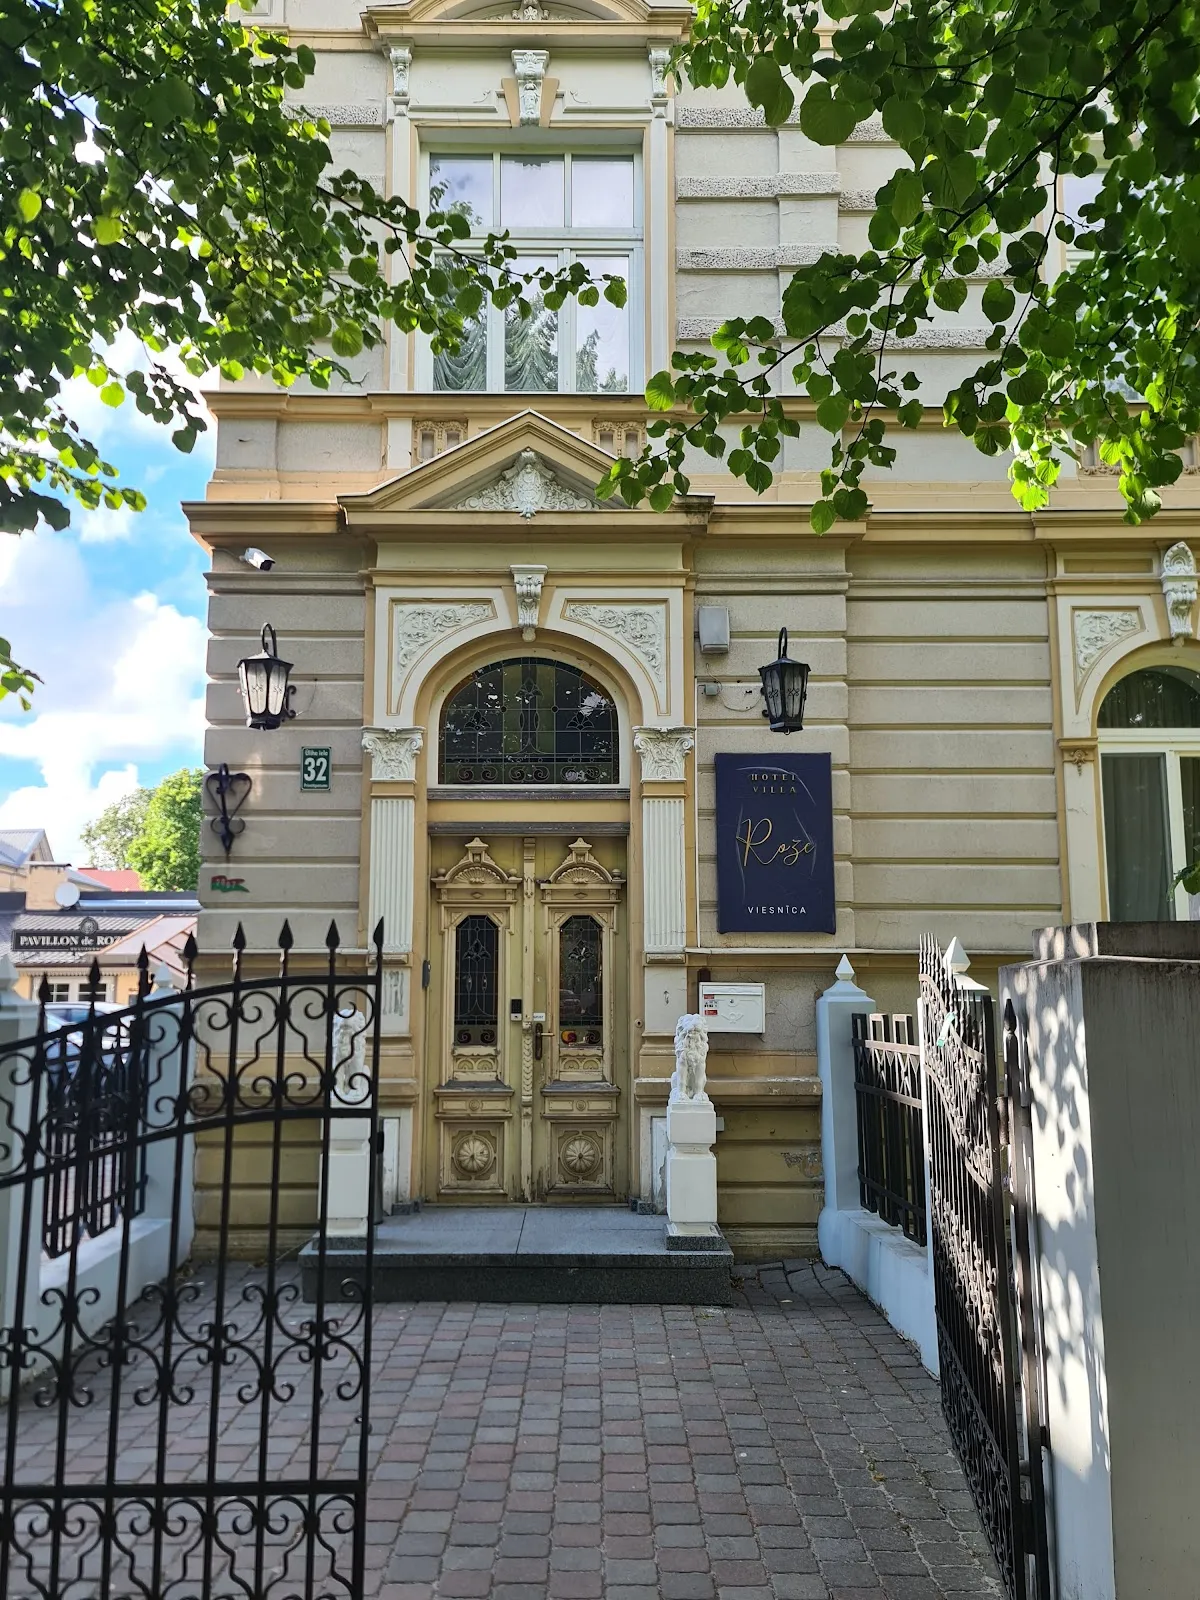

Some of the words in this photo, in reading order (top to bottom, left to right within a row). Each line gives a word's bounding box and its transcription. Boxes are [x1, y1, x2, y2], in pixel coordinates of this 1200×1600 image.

[304, 757, 327, 782] 32
[751, 773, 797, 781] HOTEL
[753, 786, 797, 794] VILLA
[748, 905, 807, 914] VIESNĪCA
[20, 936, 79, 946] PAVILLON
[81, 936, 95, 946] de
